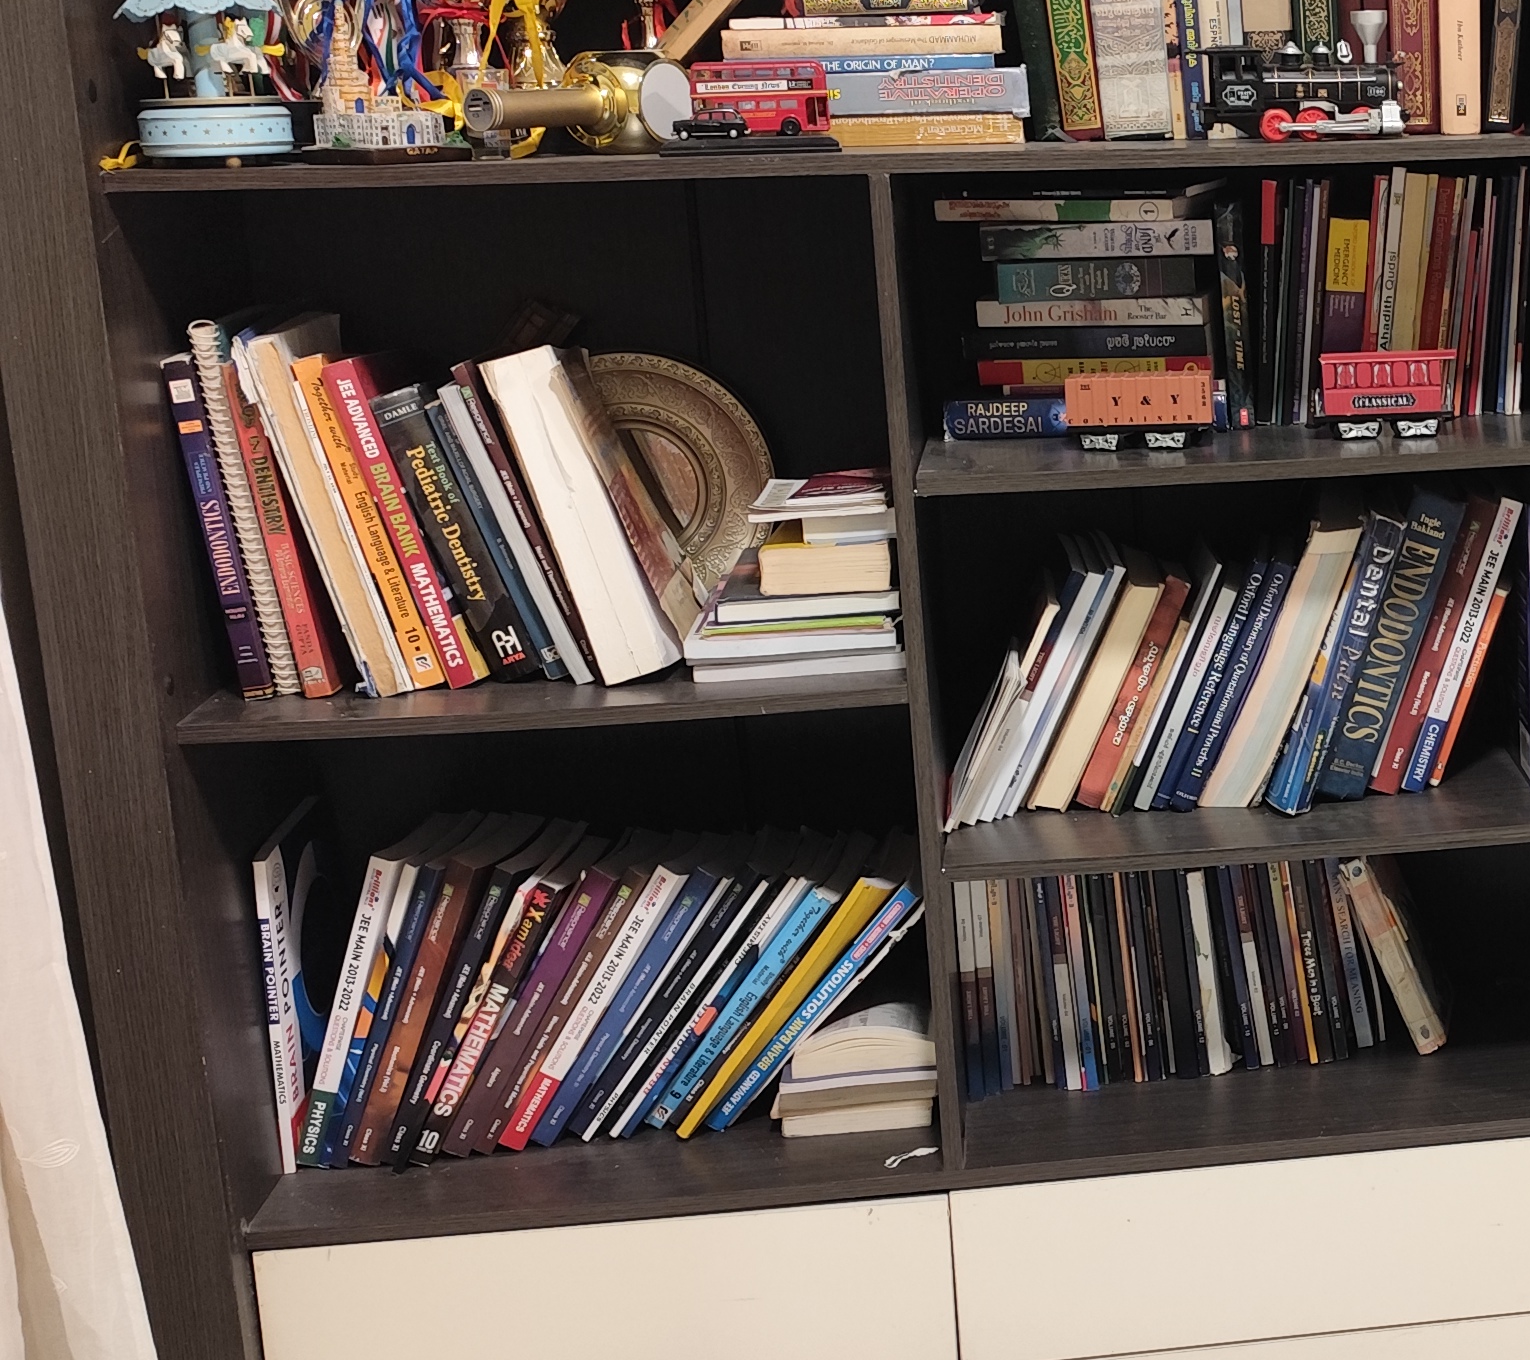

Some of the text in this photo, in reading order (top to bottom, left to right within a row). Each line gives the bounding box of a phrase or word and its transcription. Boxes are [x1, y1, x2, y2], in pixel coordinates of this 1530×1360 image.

[929, 35, 977, 44] MUHAMMAD
[844, 59, 881, 70] ORIGIN
[884, 59, 899, 69] OF
[901, 58, 934, 69] MAN?
[878, 74, 1003, 88] DENTISTRY
[878, 86, 1005, 101] OPERATIVE
[1332, 247, 1341, 286] MEDICINE
[1341, 238, 1351, 287] EMERGENCY
[1004, 304, 1117, 324] John Grisham
[1231, 296, 1241, 326] LOST
[1379, 250, 1397, 351] Ahadith Qudsi
[1234, 341, 1245, 371] TIME
[311, 377, 333, 423] Together
[383, 402, 419, 422] DAMLE
[967, 402, 1028, 416] RAJDEEP
[1111, 394, 1180, 407] Y & Y
[1358, 396, 1409, 406] CLASSICAL
[954, 417, 1042, 435] SARDESAI
[425, 440, 461, 505] Text Book of
[252, 455, 287, 535] DENTISTRY
[336, 378, 464, 668] JEE ADVANCED BRAIN BANK MATHEMATICS
[405, 445, 487, 603] Pediatric Dentistry
[1410, 522, 1446, 540] Bakland
[1420, 513, 1442, 528] Ingle
[1494, 506, 1514, 547] Brilliant
[200, 499, 241, 596] ENDODONTICS
[354, 490, 420, 644] English Language Literature 10
[281, 543, 305, 614] BASIC SCIENCES
[1237, 573, 1263, 621] Oxford
[1264, 573, 1285, 609] Oxford
[1348, 542, 1395, 638] Dental
[1460, 549, 1500, 644] JEE MAIN 2013-2022
[295, 624, 307, 655] GUPTA
[1214, 614, 1247, 670] Language
[1247, 606, 1273, 653] Dictionary
[1342, 538, 1441, 744] ENDODONTICS
[1241, 652, 1249, 664] of
[1465, 641, 1487, 689] Punctuation
[1189, 671, 1223, 727] Reference
[1219, 663, 1247, 709] Quotations
[1214, 708, 1226, 728] and
[1195, 725, 1220, 770] Proverbs
[1412, 723, 1441, 782] CHEMISTRY
[366, 869, 383, 910] Brilliant
[642, 875, 667, 914] Brilliant
[559, 906, 586, 950] Resonance
[792, 905, 822, 937] Together
[1336, 903, 1352, 943] SEARCH
[338, 913, 372, 1012] JEE MAIN 2013-2022
[588, 915, 645, 1006] JEE MAIN 2013-2022
[1301, 930, 1312, 957] Three
[1344, 946, 1355, 967] FOR
[260, 923, 279, 1023] BRAIN POINTER
[1304, 958, 1316, 980] Men
[274, 902, 300, 1102] BRAIN POINTER
[737, 991, 758, 1014] English
[1310, 994, 1323, 1016] Boat
[1347, 967, 1363, 1014] MEANING
[644, 983, 696, 1055] BRAIN POINTER
[711, 1011, 743, 1050] Language
[721, 1103, 734, 1116] JEE
[729, 1070, 761, 1108] ADVANCED
[757, 1044, 785, 1071] BRAIN
[779, 1017, 806, 1048] BANK
[801, 959, 854, 1019] SOLUTIONS
[433, 982, 509, 1117] MATHEMATICS
[273, 1040, 287, 1105] MATHEMATICS
[409, 1040, 442, 1105] Coordinate Geometry
[486, 1067, 501, 1088] Algebra
[681, 1055, 711, 1088] Literature
[515, 1077, 553, 1133] MATHEMATICS
[596, 1092, 619, 1123] PHYSICS
[302, 1100, 327, 1155] PHYSICS
[419, 1130, 440, 1150] 10
